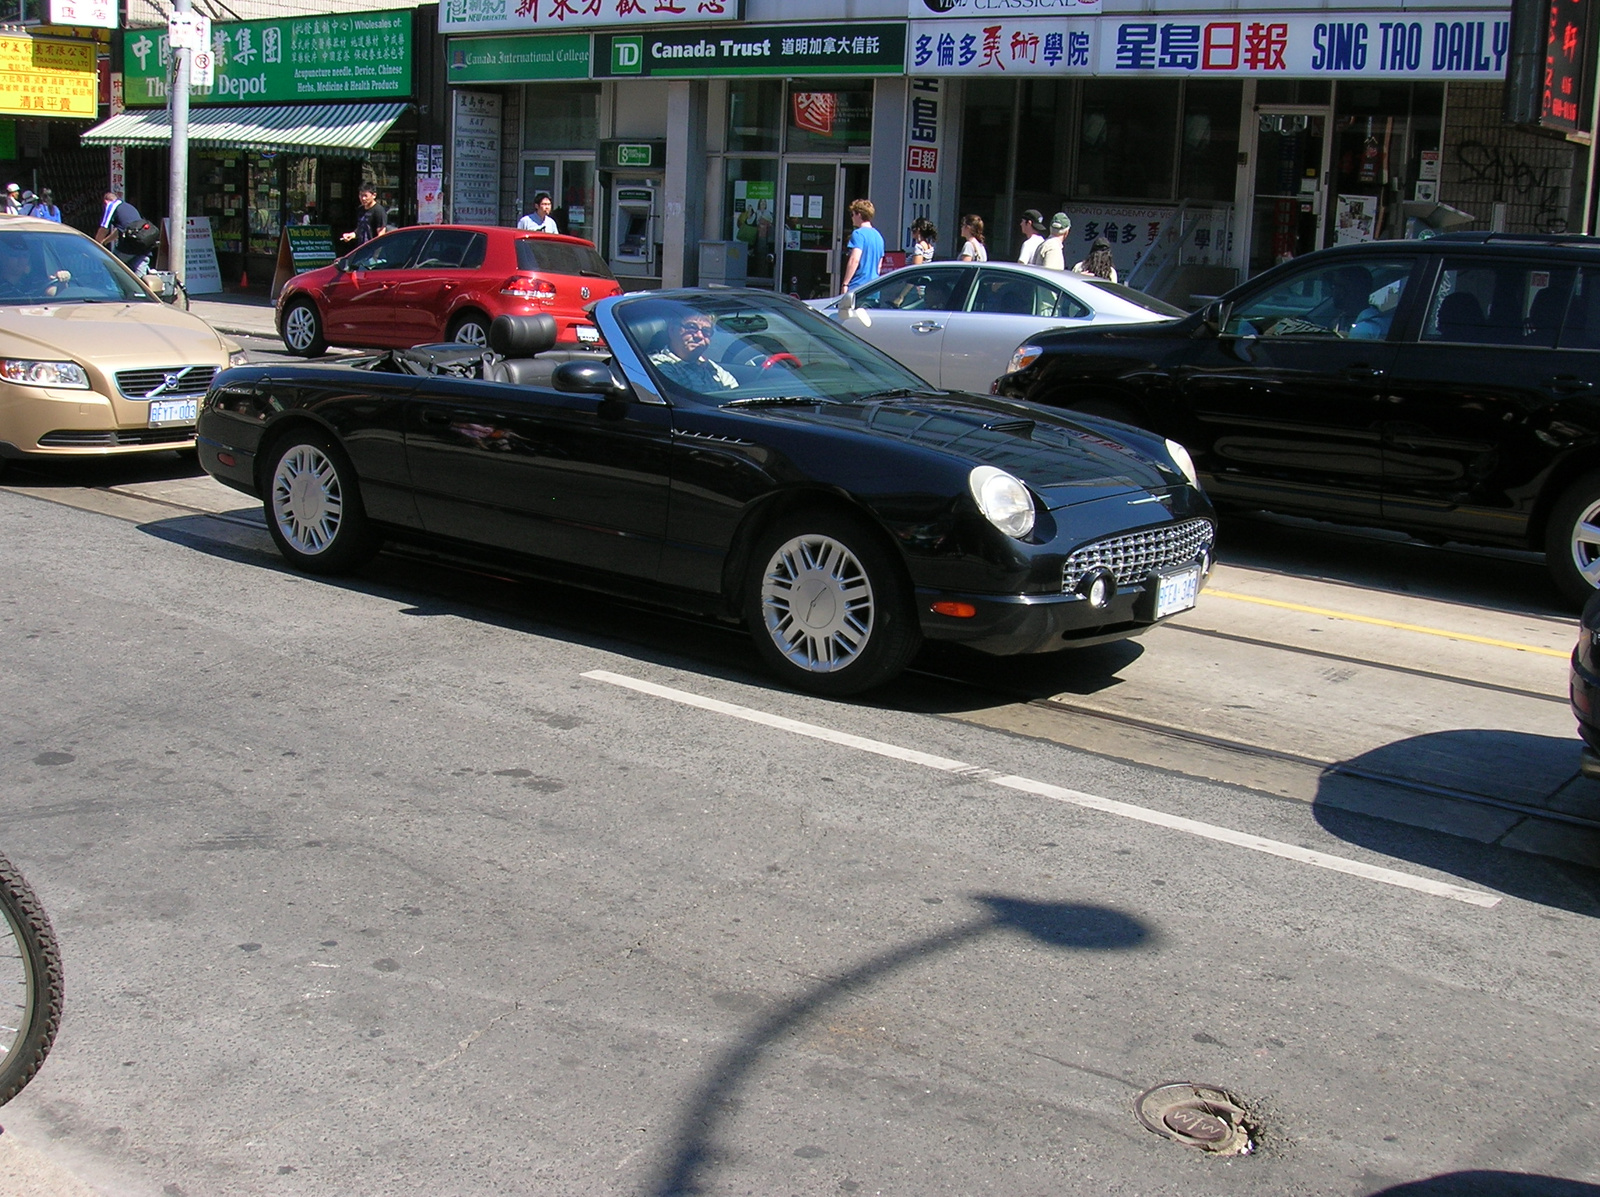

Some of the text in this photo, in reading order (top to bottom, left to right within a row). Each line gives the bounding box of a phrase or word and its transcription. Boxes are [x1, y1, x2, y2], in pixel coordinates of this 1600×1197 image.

[354, 18, 391, 30] Wholesales
[131, 27, 282, 71] 中國業集團
[614, 43, 639, 66] TD
[651, 39, 771, 59] Canada Trust
[781, 36, 880, 55] 道明加拿大信託
[1115, 22, 1289, 71] 星島日報
[1311, 21, 1509, 72] SING TAO DAILY
[465, 48, 590, 66] Canada International College
[294, 64, 402, 80] Acupuncture needle, Device, Chinese
[218, 72, 267, 100] Depot
[297, 81, 316, 92] Herbs,
[316, 80, 343, 92] Medicine
[350, 79, 370, 90] Health
[371, 78, 399, 90] Products
[909, 148, 935, 170] 日報
[909, 178, 932, 200] SING
[1064, 206, 1102, 216] TORONTO
[1105, 207, 1146, 217] ACADEMY
[1147, 209, 1158, 219] OF
[289, 228, 331, 238] The Herb Depot
